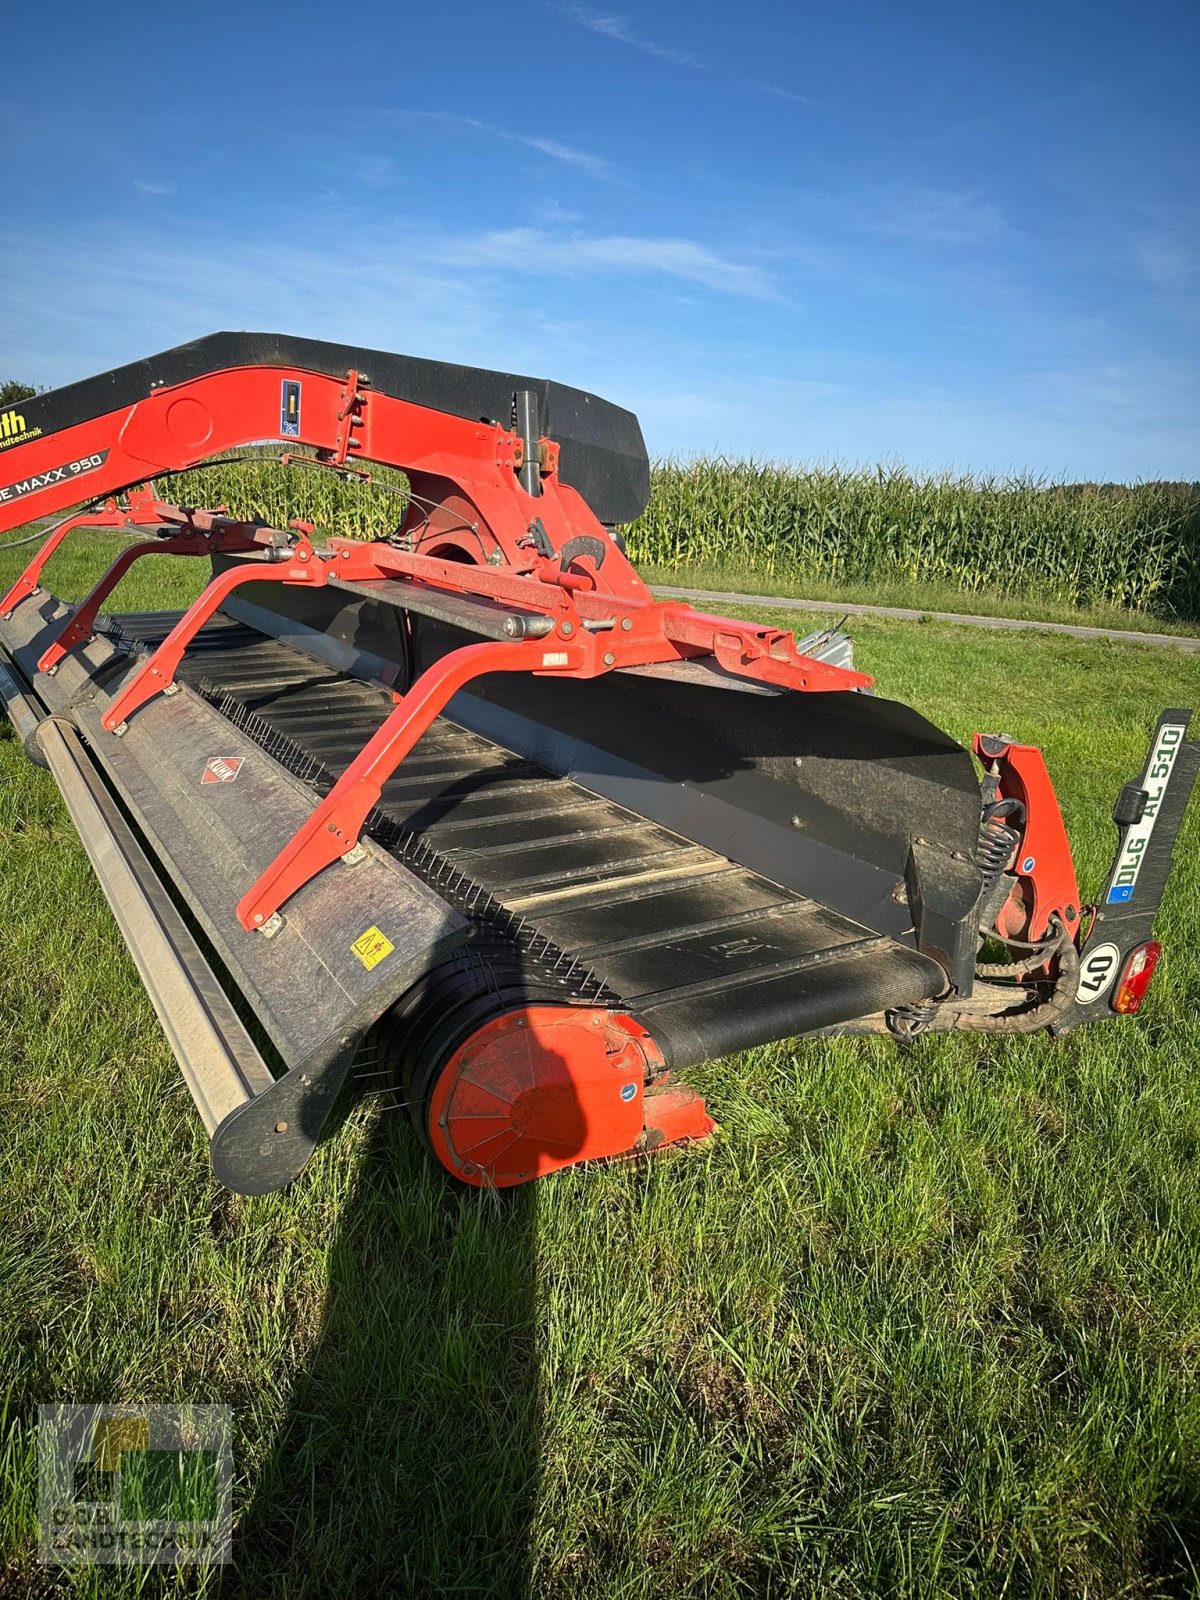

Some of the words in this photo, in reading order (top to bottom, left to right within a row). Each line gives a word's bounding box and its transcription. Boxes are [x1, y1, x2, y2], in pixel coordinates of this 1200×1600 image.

[0, 487, 13, 501] E
[15, 467, 67, 494] MAXX
[70, 454, 102, 473] 950
[207, 758, 236, 781] KUHN
[1151, 730, 1180, 779] 510
[1143, 786, 1163, 818] AL
[1115, 838, 1146, 886] DLG
[1081, 956, 1113, 991] 40
